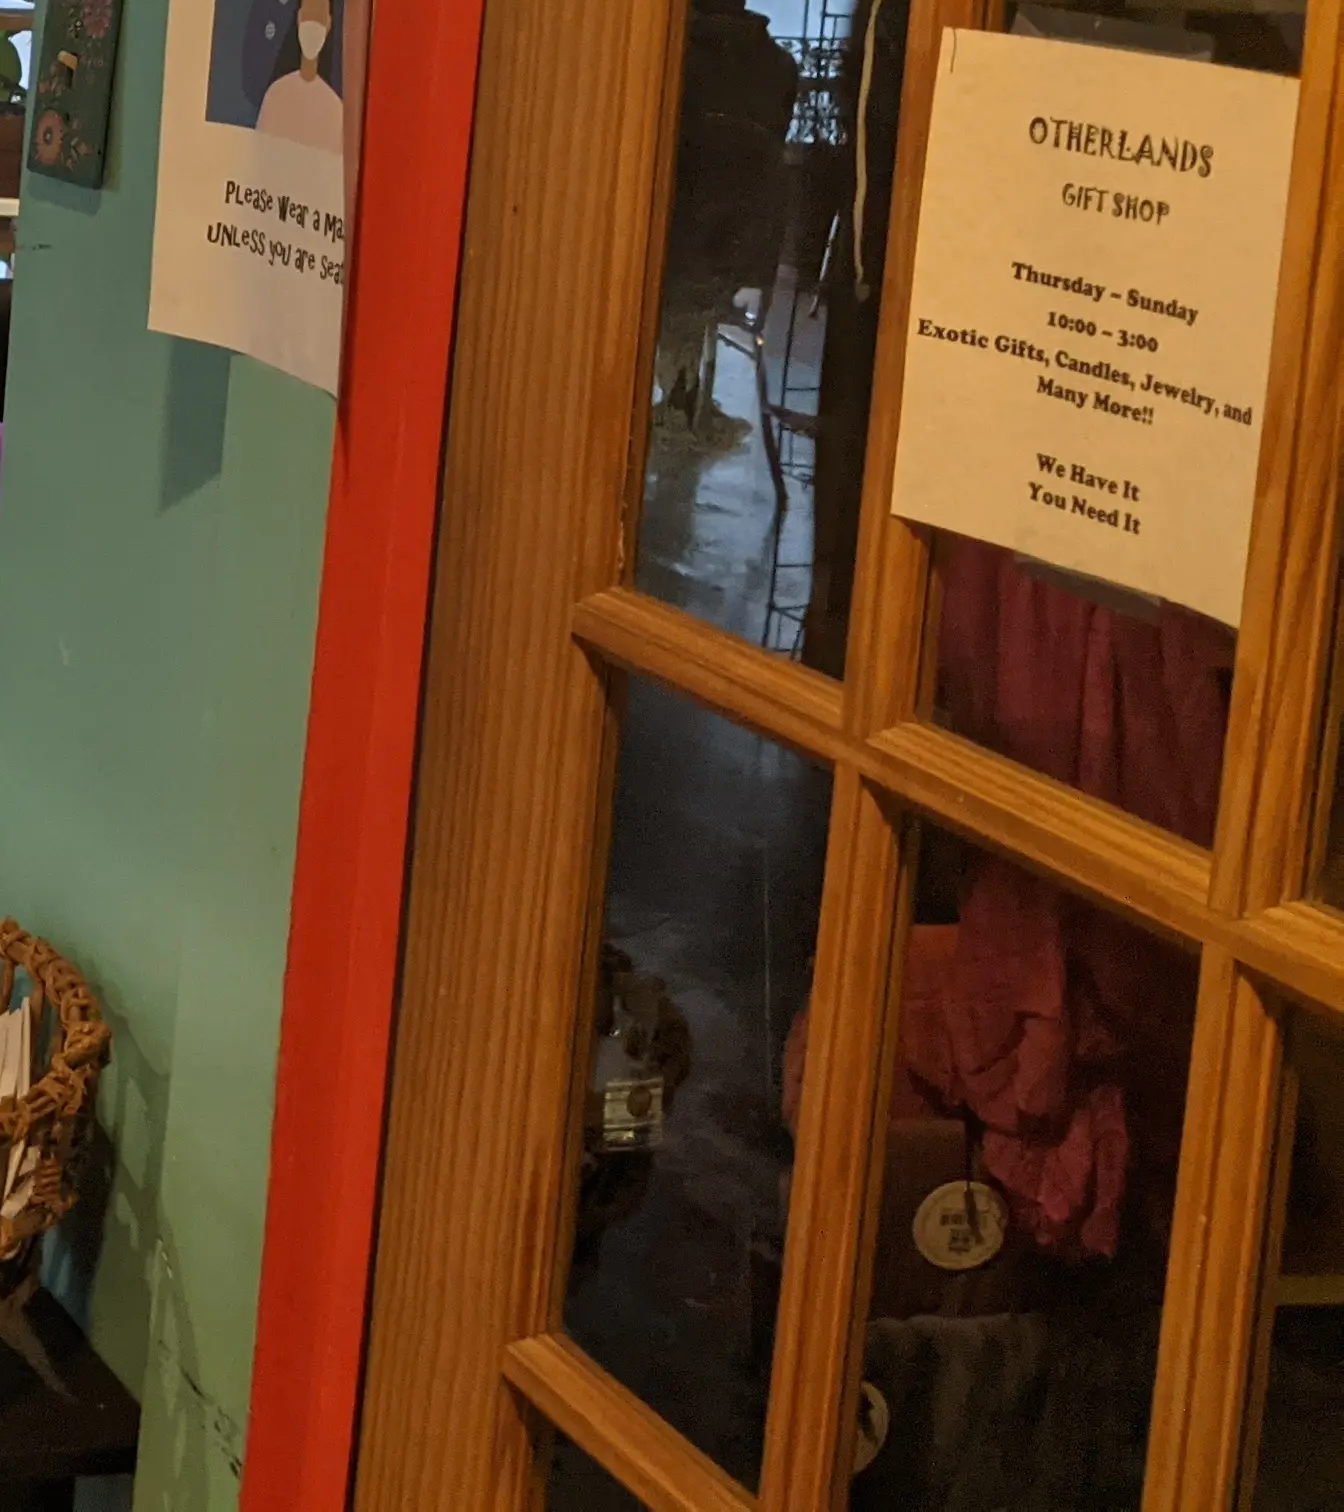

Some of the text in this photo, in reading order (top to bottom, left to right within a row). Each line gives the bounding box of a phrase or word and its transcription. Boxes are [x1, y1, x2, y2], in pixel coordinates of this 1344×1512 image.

[1028, 116, 1215, 179] OTHERLANDS
[277, 195, 309, 229] Wear
[312, 209, 320, 232] a
[324, 212, 344, 243] Ma
[1061, 182, 1170, 226] GIFT SHOP
[294, 247, 315, 273] are
[1011, 261, 1106, 303] Thursday
[1126, 287, 1200, 326] Sunday
[1046, 311, 1097, 341] 10:00
[1117, 328, 1159, 354] 3:00
[916, 317, 1253, 426] Exotic Gifts, Candles, Jewelry, and
[1036, 375, 1155, 425] Many More!!
[1036, 452, 1141, 503] We Have It
[1027, 483, 1142, 536] You Need It
